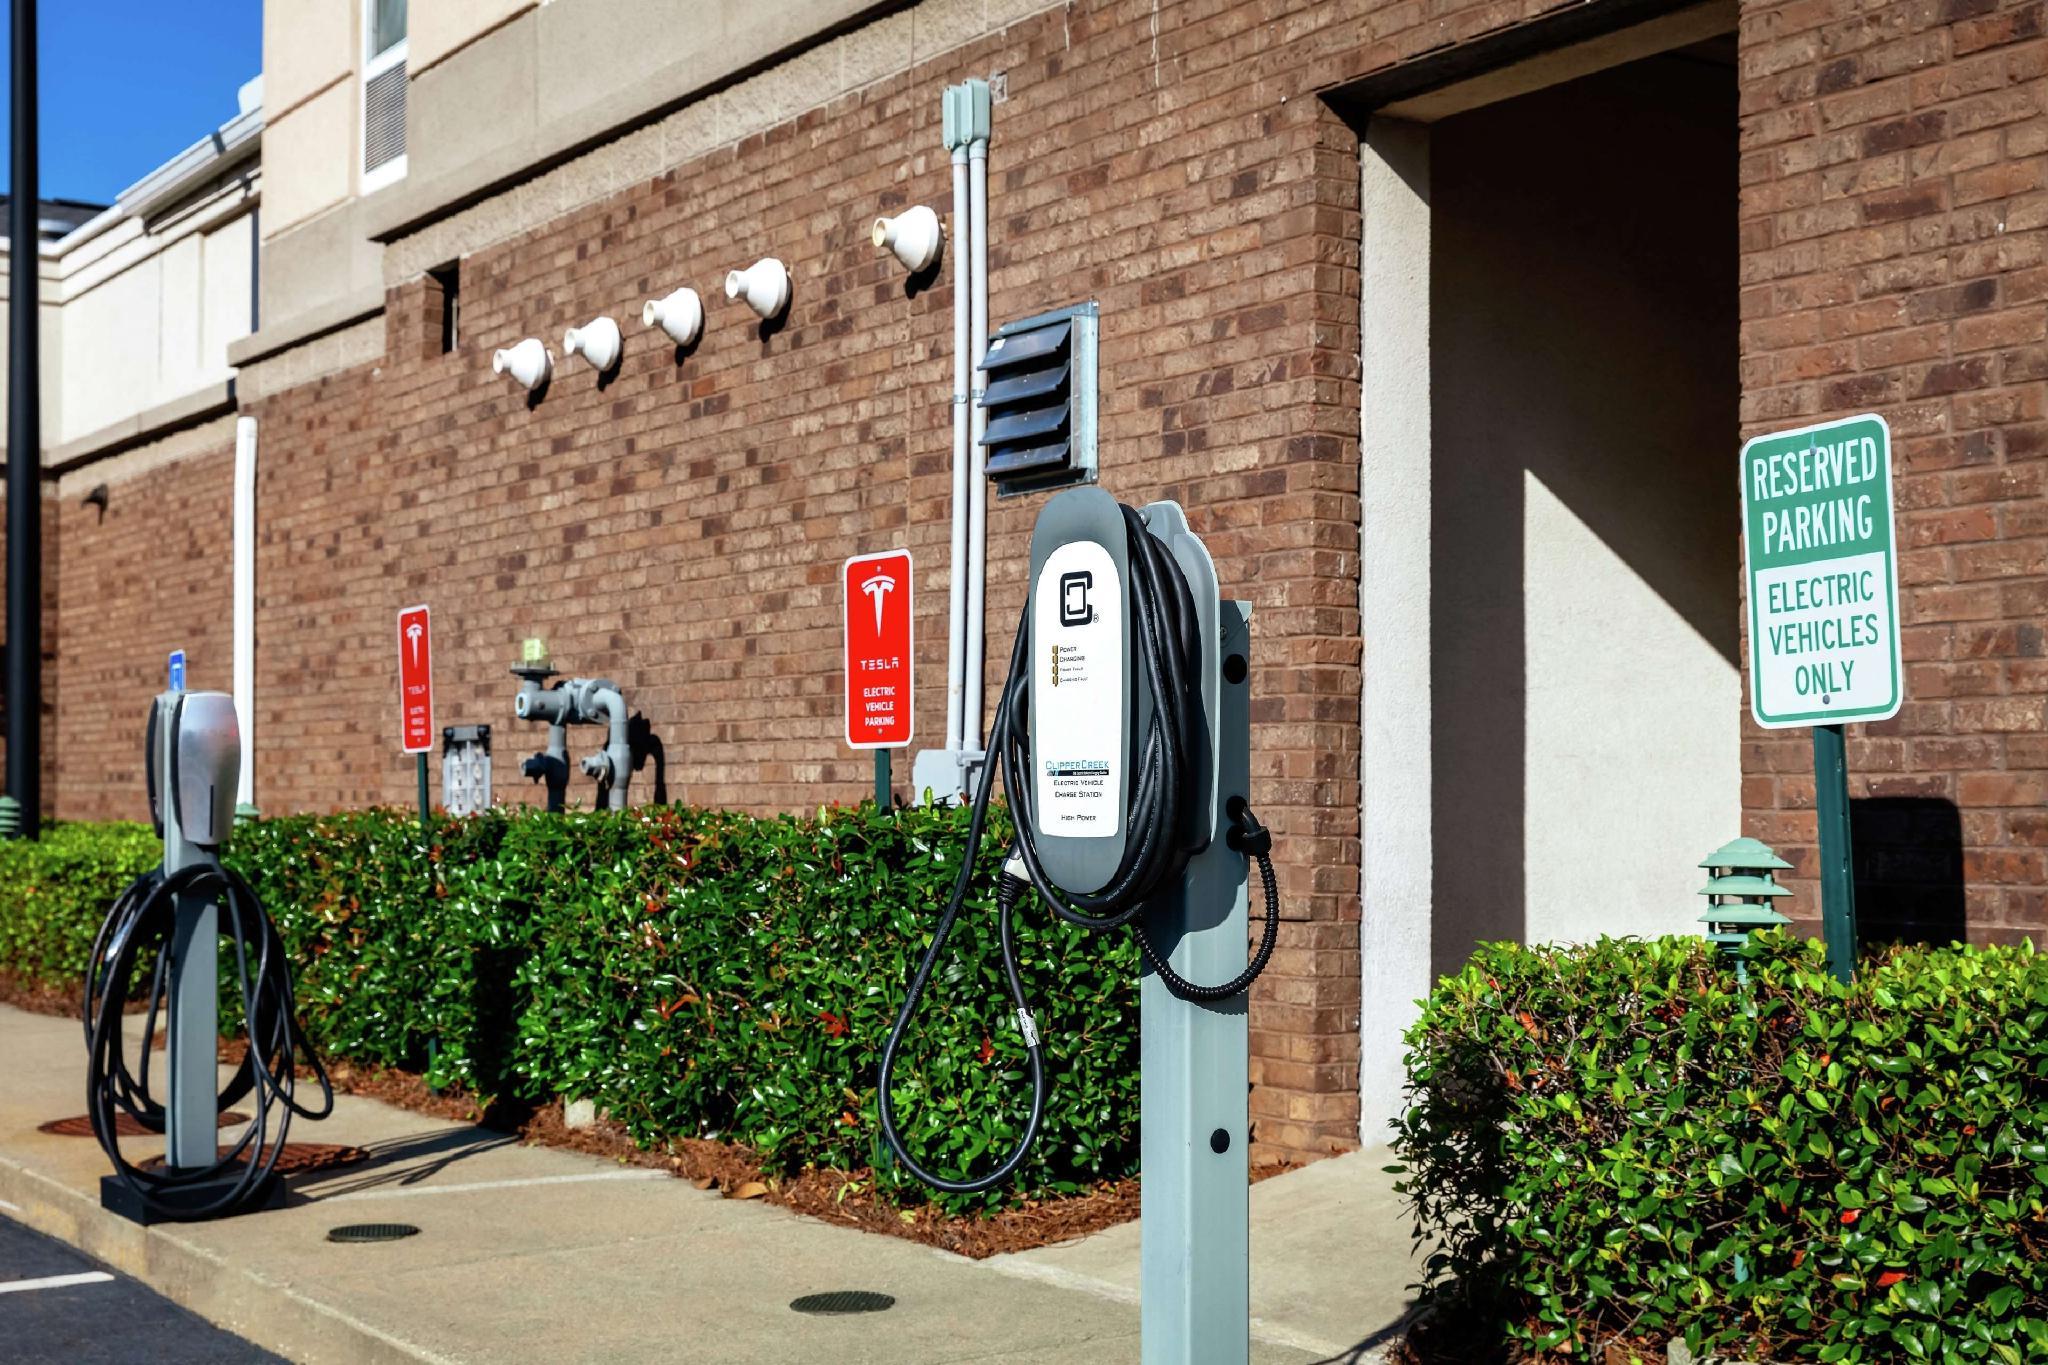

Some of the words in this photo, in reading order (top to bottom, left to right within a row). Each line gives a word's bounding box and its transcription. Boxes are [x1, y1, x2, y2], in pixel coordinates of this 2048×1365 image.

[1753, 436, 1877, 501] RESERVED
[1762, 494, 1873, 554] PARKING
[1769, 570, 1874, 614] ELECTRIC
[1769, 613, 1878, 655] VEHICLES
[860, 657, 899, 670] TESLA
[1795, 660, 1855, 696] ONLY
[863, 686, 896, 698] ELECTRIC
[865, 701, 894, 712] VEHICLE
[864, 716, 895, 726] PARKING
